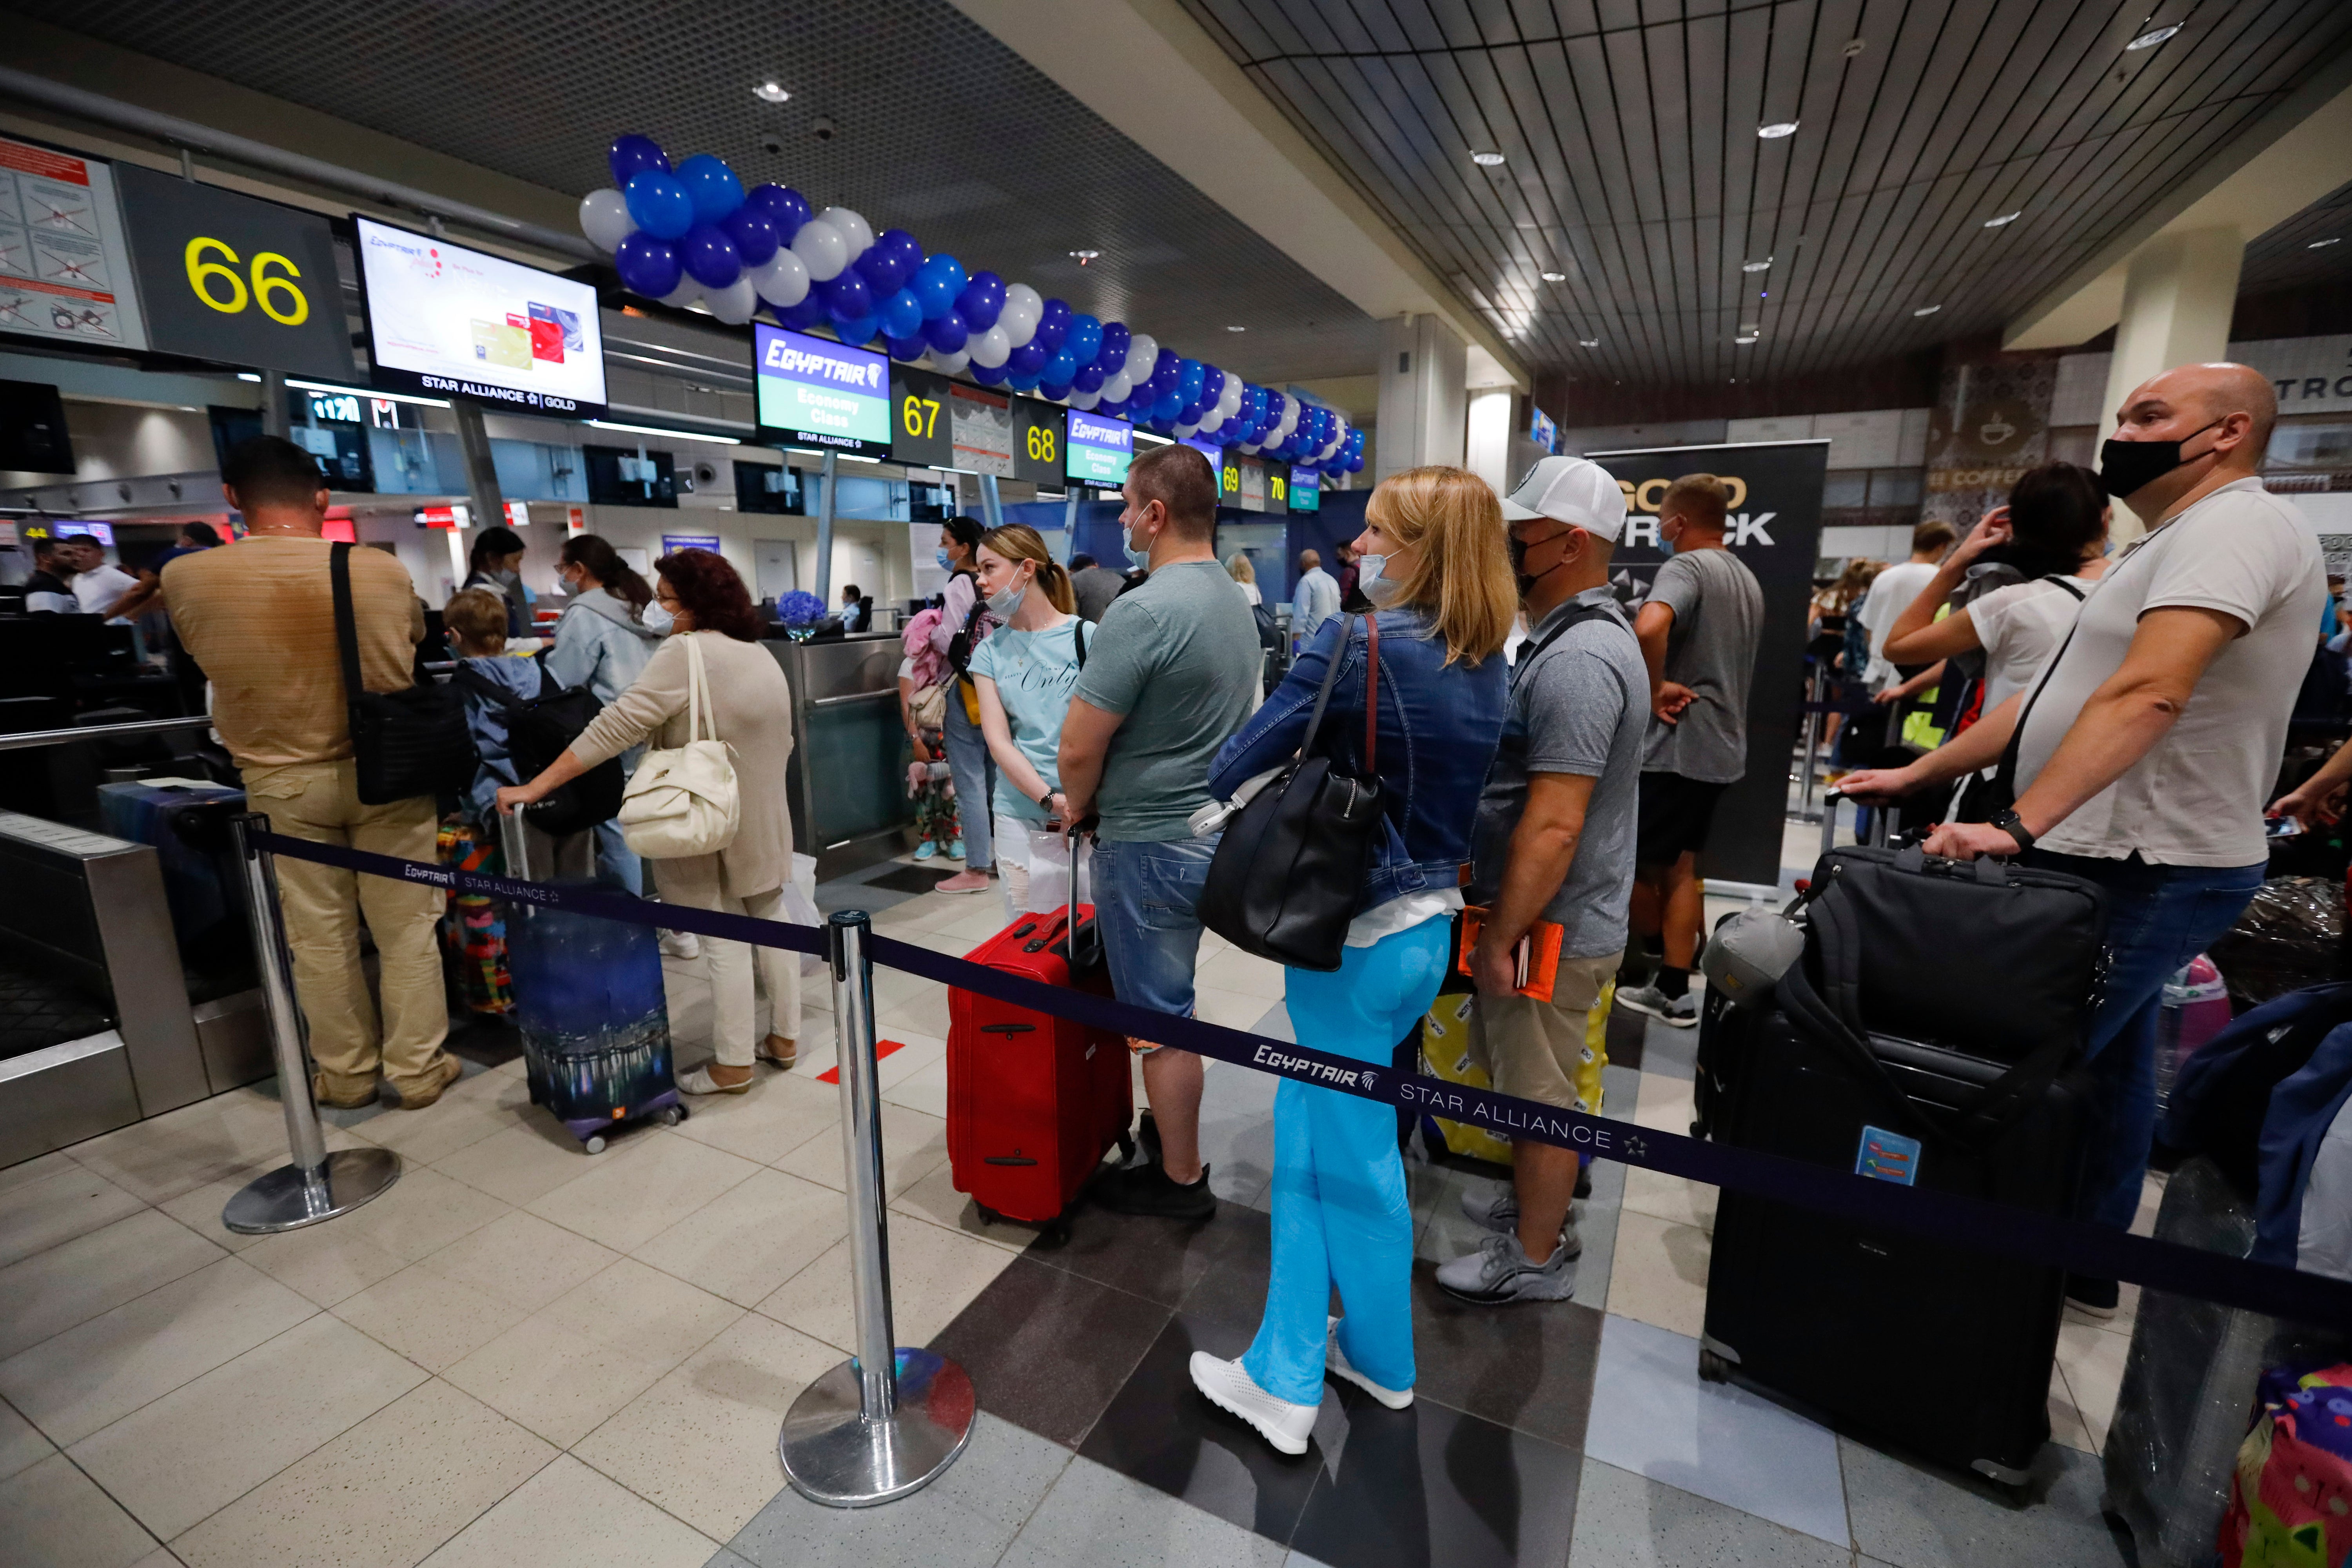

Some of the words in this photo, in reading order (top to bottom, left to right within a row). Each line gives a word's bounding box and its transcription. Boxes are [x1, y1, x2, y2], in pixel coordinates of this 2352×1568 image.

[185, 237, 309, 326] 66
[765, 338, 866, 386] EGYPTAIR
[422, 376, 459, 392] STAR
[461, 382, 525, 403] ALLIANCE
[544, 396, 576, 411] GOLD
[797, 387, 858, 416] Economy
[811, 408, 849, 428] Class
[904, 395, 940, 439] 67
[1071, 417, 1122, 445] EGYPTAIR
[797, 432, 818, 442] STAR
[818, 435, 855, 448] ALLIANCE
[1027, 426, 1055, 463] 68
[1085, 449, 1117, 466] Economy
[1091, 462, 1111, 475] Class
[1223, 466, 1239, 492] 69
[1270, 476, 1285, 501] 70
[1616, 476, 1747, 512] GOD
[1022, 659, 1078, 698] Only
[405, 864, 449, 884] EGYPTAIR
[464, 877, 491, 891] STAR
[494, 882, 546, 901] ALLIANCE
[1253, 1044, 1359, 1087] EGYPTAIR
[1400, 1083, 1463, 1112] STAR
[1473, 1102, 1612, 1149] ALLIANCE
